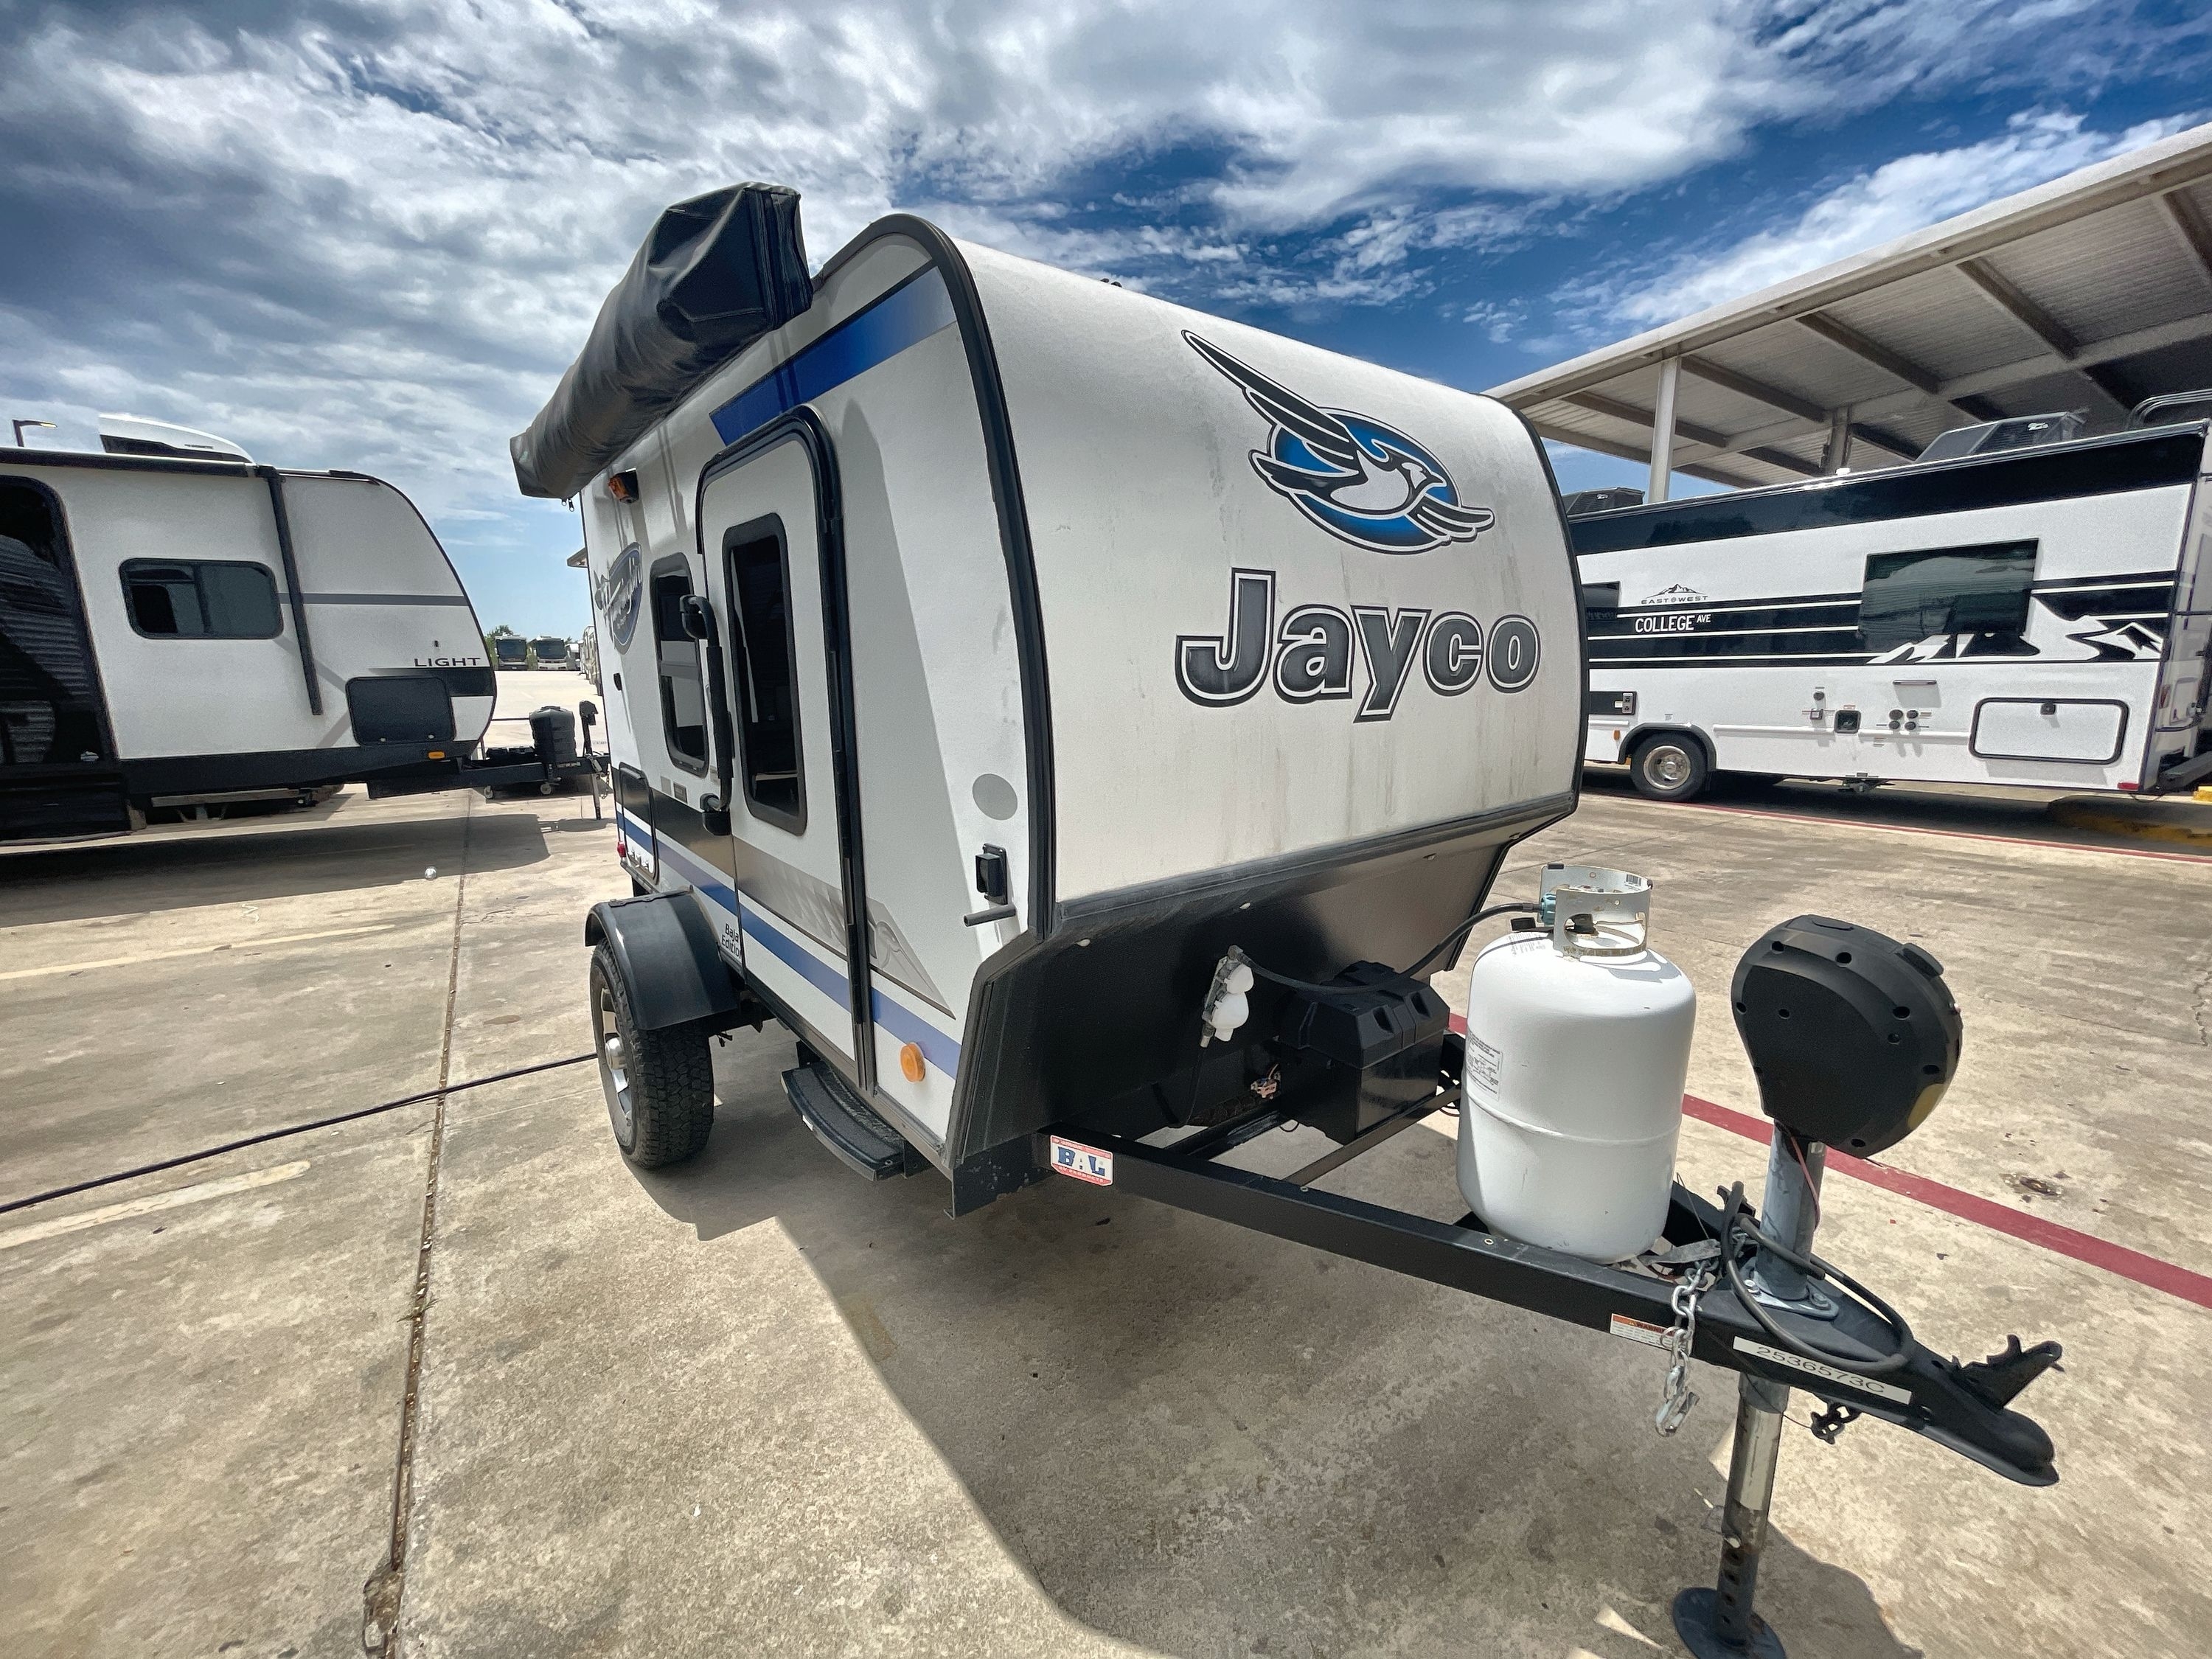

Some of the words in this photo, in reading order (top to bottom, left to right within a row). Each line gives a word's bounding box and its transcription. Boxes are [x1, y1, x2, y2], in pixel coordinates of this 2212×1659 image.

[1635, 614, 1695, 633] COLLEGE
[1696, 613, 1711, 623] AVE
[1175, 567, 1540, 723] Jayco
[414, 657, 481, 667] LIGHT
[725, 922, 740, 943] Baja
[1057, 1146, 1105, 1177] BAL
[1756, 1346, 1885, 1394] 2536573C
